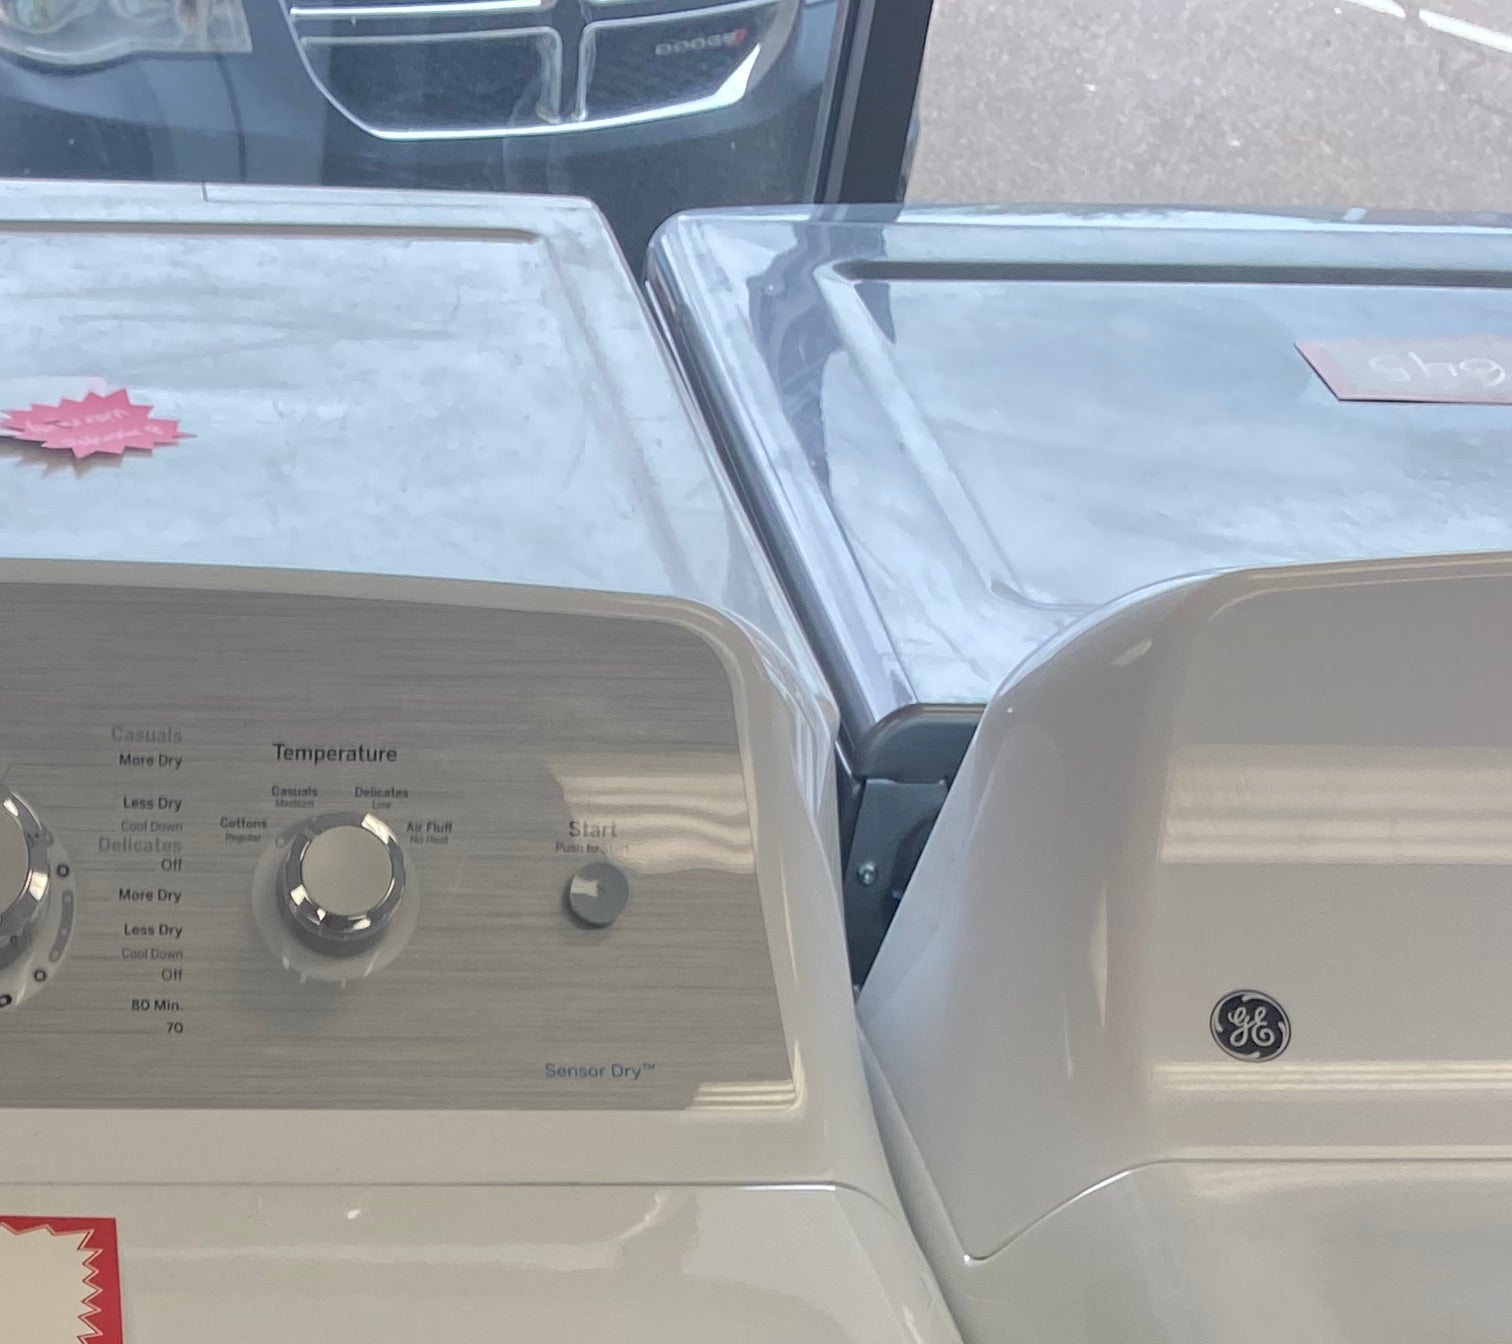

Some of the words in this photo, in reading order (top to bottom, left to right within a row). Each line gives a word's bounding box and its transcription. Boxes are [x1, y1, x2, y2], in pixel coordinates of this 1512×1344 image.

[111, 726, 183, 744] Casuals
[120, 753, 154, 767] More
[159, 754, 183, 770] Dry
[273, 744, 398, 765] Temperature
[354, 787, 409, 798] Delicates
[123, 796, 154, 809] Less
[158, 797, 182, 812] Dry
[220, 817, 267, 830] Cottons
[406, 822, 422, 833] Air
[426, 822, 453, 833] Fluff
[569, 820, 617, 837] Start
[98, 837, 182, 852] Delicates
[161, 858, 182, 872] Off
[119, 888, 154, 901] More
[158, 889, 182, 903] Dry
[124, 923, 154, 936] Less
[159, 924, 183, 939] Dry
[161, 968, 183, 981] Off
[132, 1000, 150, 1011] 80
[154, 1000, 183, 1011] Min.
[166, 1022, 183, 1034] 70
[545, 1063, 605, 1078] Sensor
